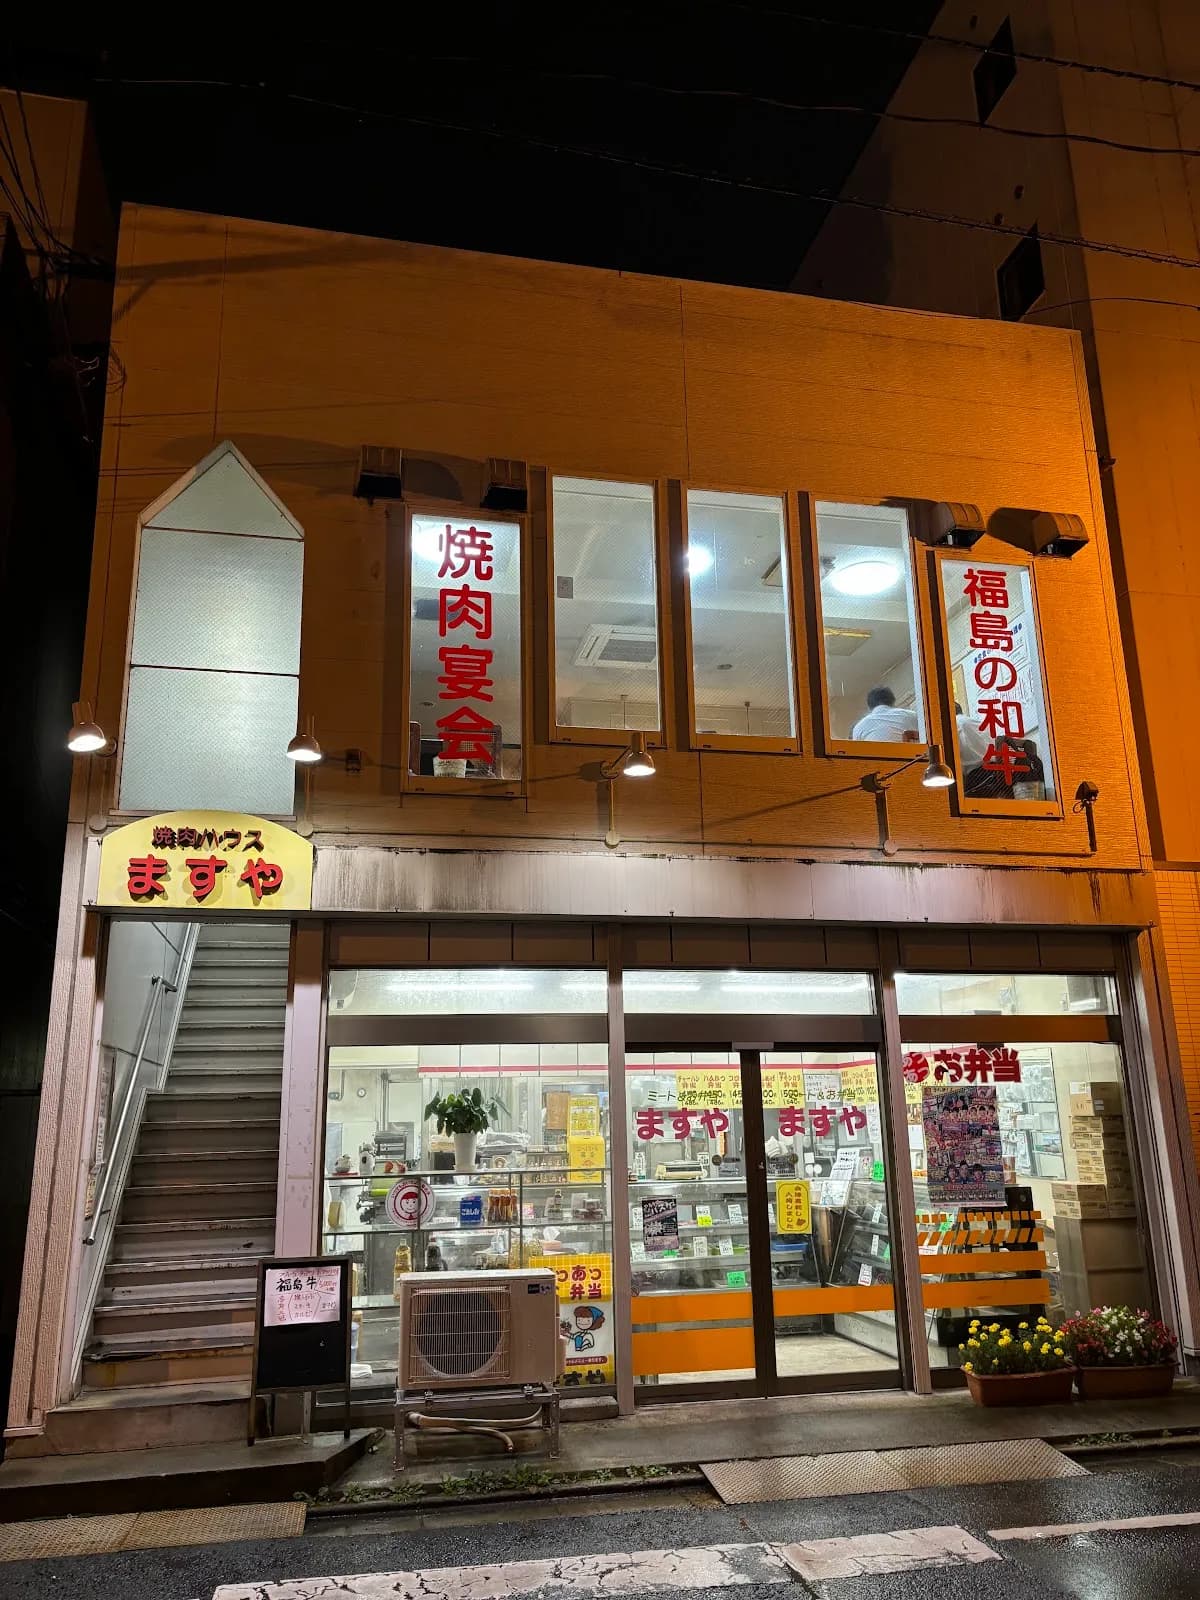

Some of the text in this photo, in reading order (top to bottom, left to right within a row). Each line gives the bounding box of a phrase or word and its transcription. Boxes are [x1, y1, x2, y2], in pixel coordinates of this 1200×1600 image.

[436, 523, 494, 764] 焼肉宴会
[963, 568, 1031, 786] 福島の和牛
[152, 825, 265, 853] 焼肉ハウス
[127, 854, 284, 902] ますや
[934, 1048, 1022, 1083] お弁当
[637, 1107, 729, 1140] ますや
[778, 1106, 867, 1137] ますや
[276, 1275, 317, 1292] 福島牛
